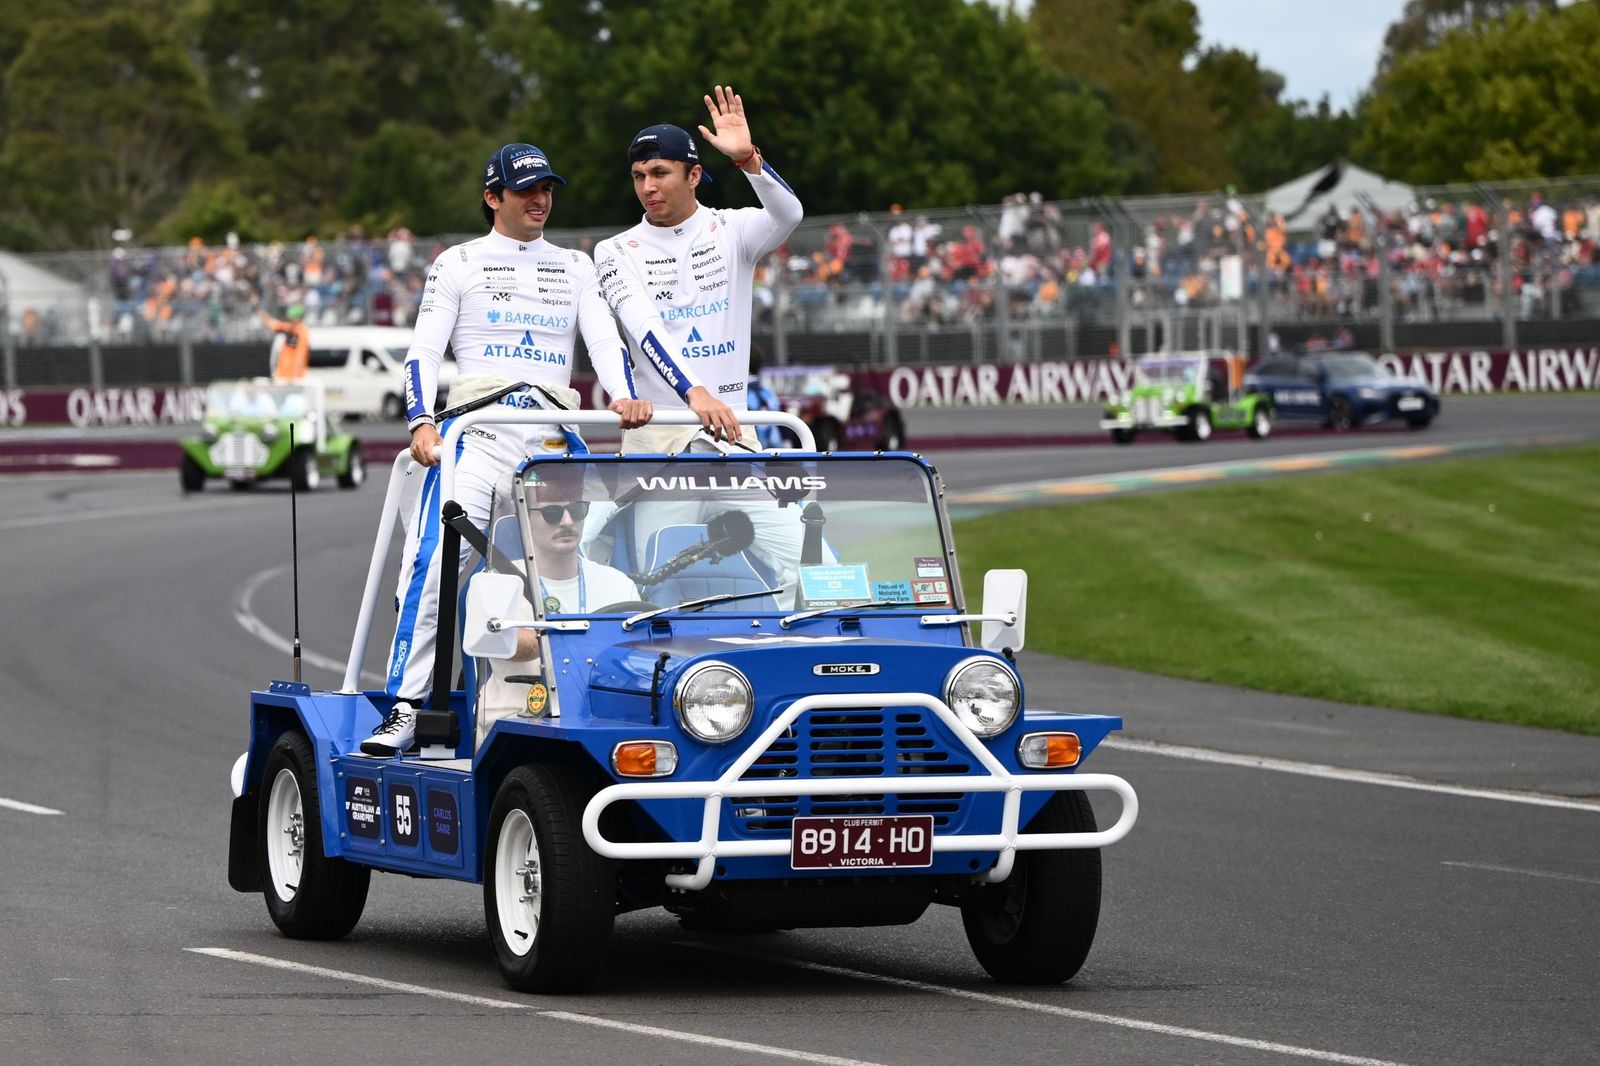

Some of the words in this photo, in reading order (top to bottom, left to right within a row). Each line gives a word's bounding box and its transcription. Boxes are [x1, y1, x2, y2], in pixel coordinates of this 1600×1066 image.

[645, 257, 677, 265] KOMATSU
[692, 255, 722, 270] DURACELL
[668, 297, 729, 321] BARCLAYS
[504, 311, 569, 329] BARCLAYS
[483, 344, 566, 366] ATLASSIAN
[641, 338, 680, 386] KOMATSU
[1502, 347, 1600, 393] AIRW
[718, 382, 744, 394] sparco
[888, 363, 1001, 409] QATAR
[67, 387, 156, 428] QATAR
[636, 475, 828, 491] WILLIAMS
[829, 665, 864, 674] MOKE
[395, 794, 412, 836] 55
[843, 819, 860, 827] CLUB
[860, 819, 884, 827] PERMIT
[840, 857, 884, 867] VICTORIA
